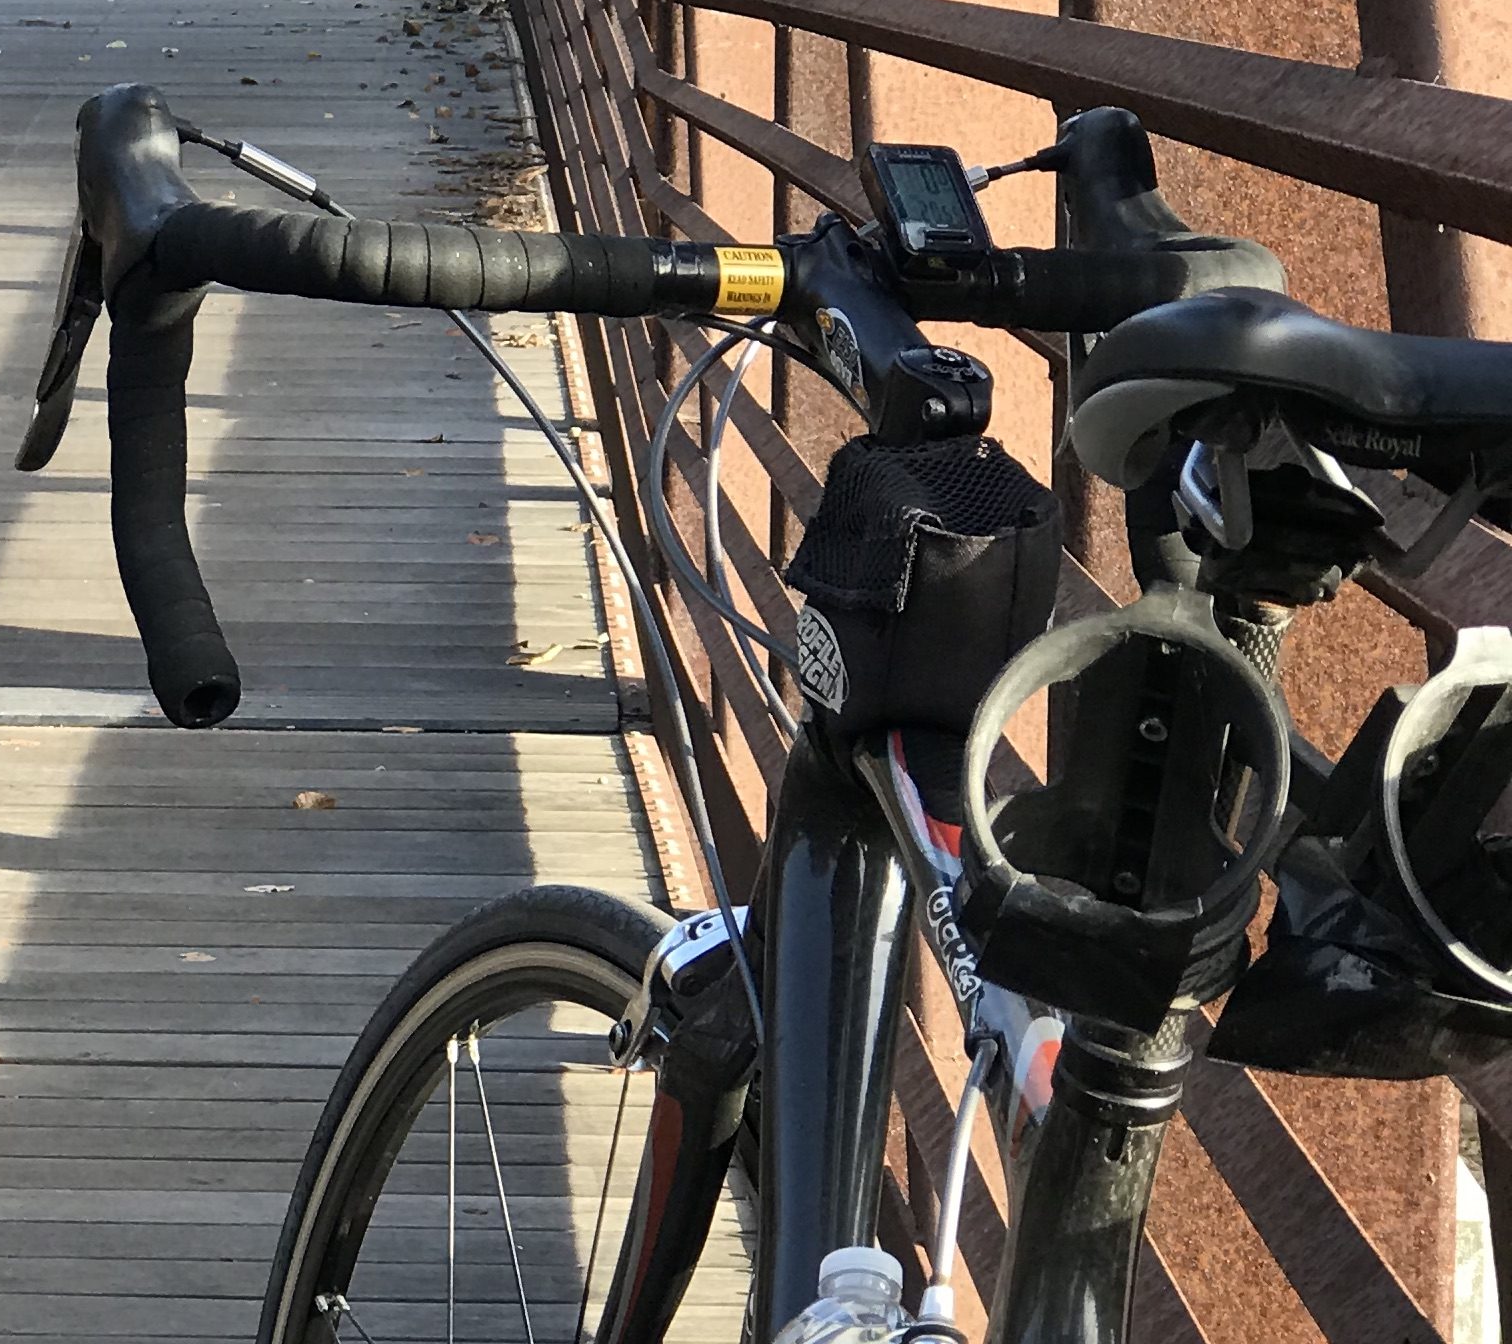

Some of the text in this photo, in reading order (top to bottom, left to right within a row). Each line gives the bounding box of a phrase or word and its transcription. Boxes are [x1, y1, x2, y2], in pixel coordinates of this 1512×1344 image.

[723, 250, 774, 262] CAUTION
[748, 275, 775, 286] SAFETY
[1364, 431, 1422, 461] Royal
[797, 612, 841, 677] ROFILE
